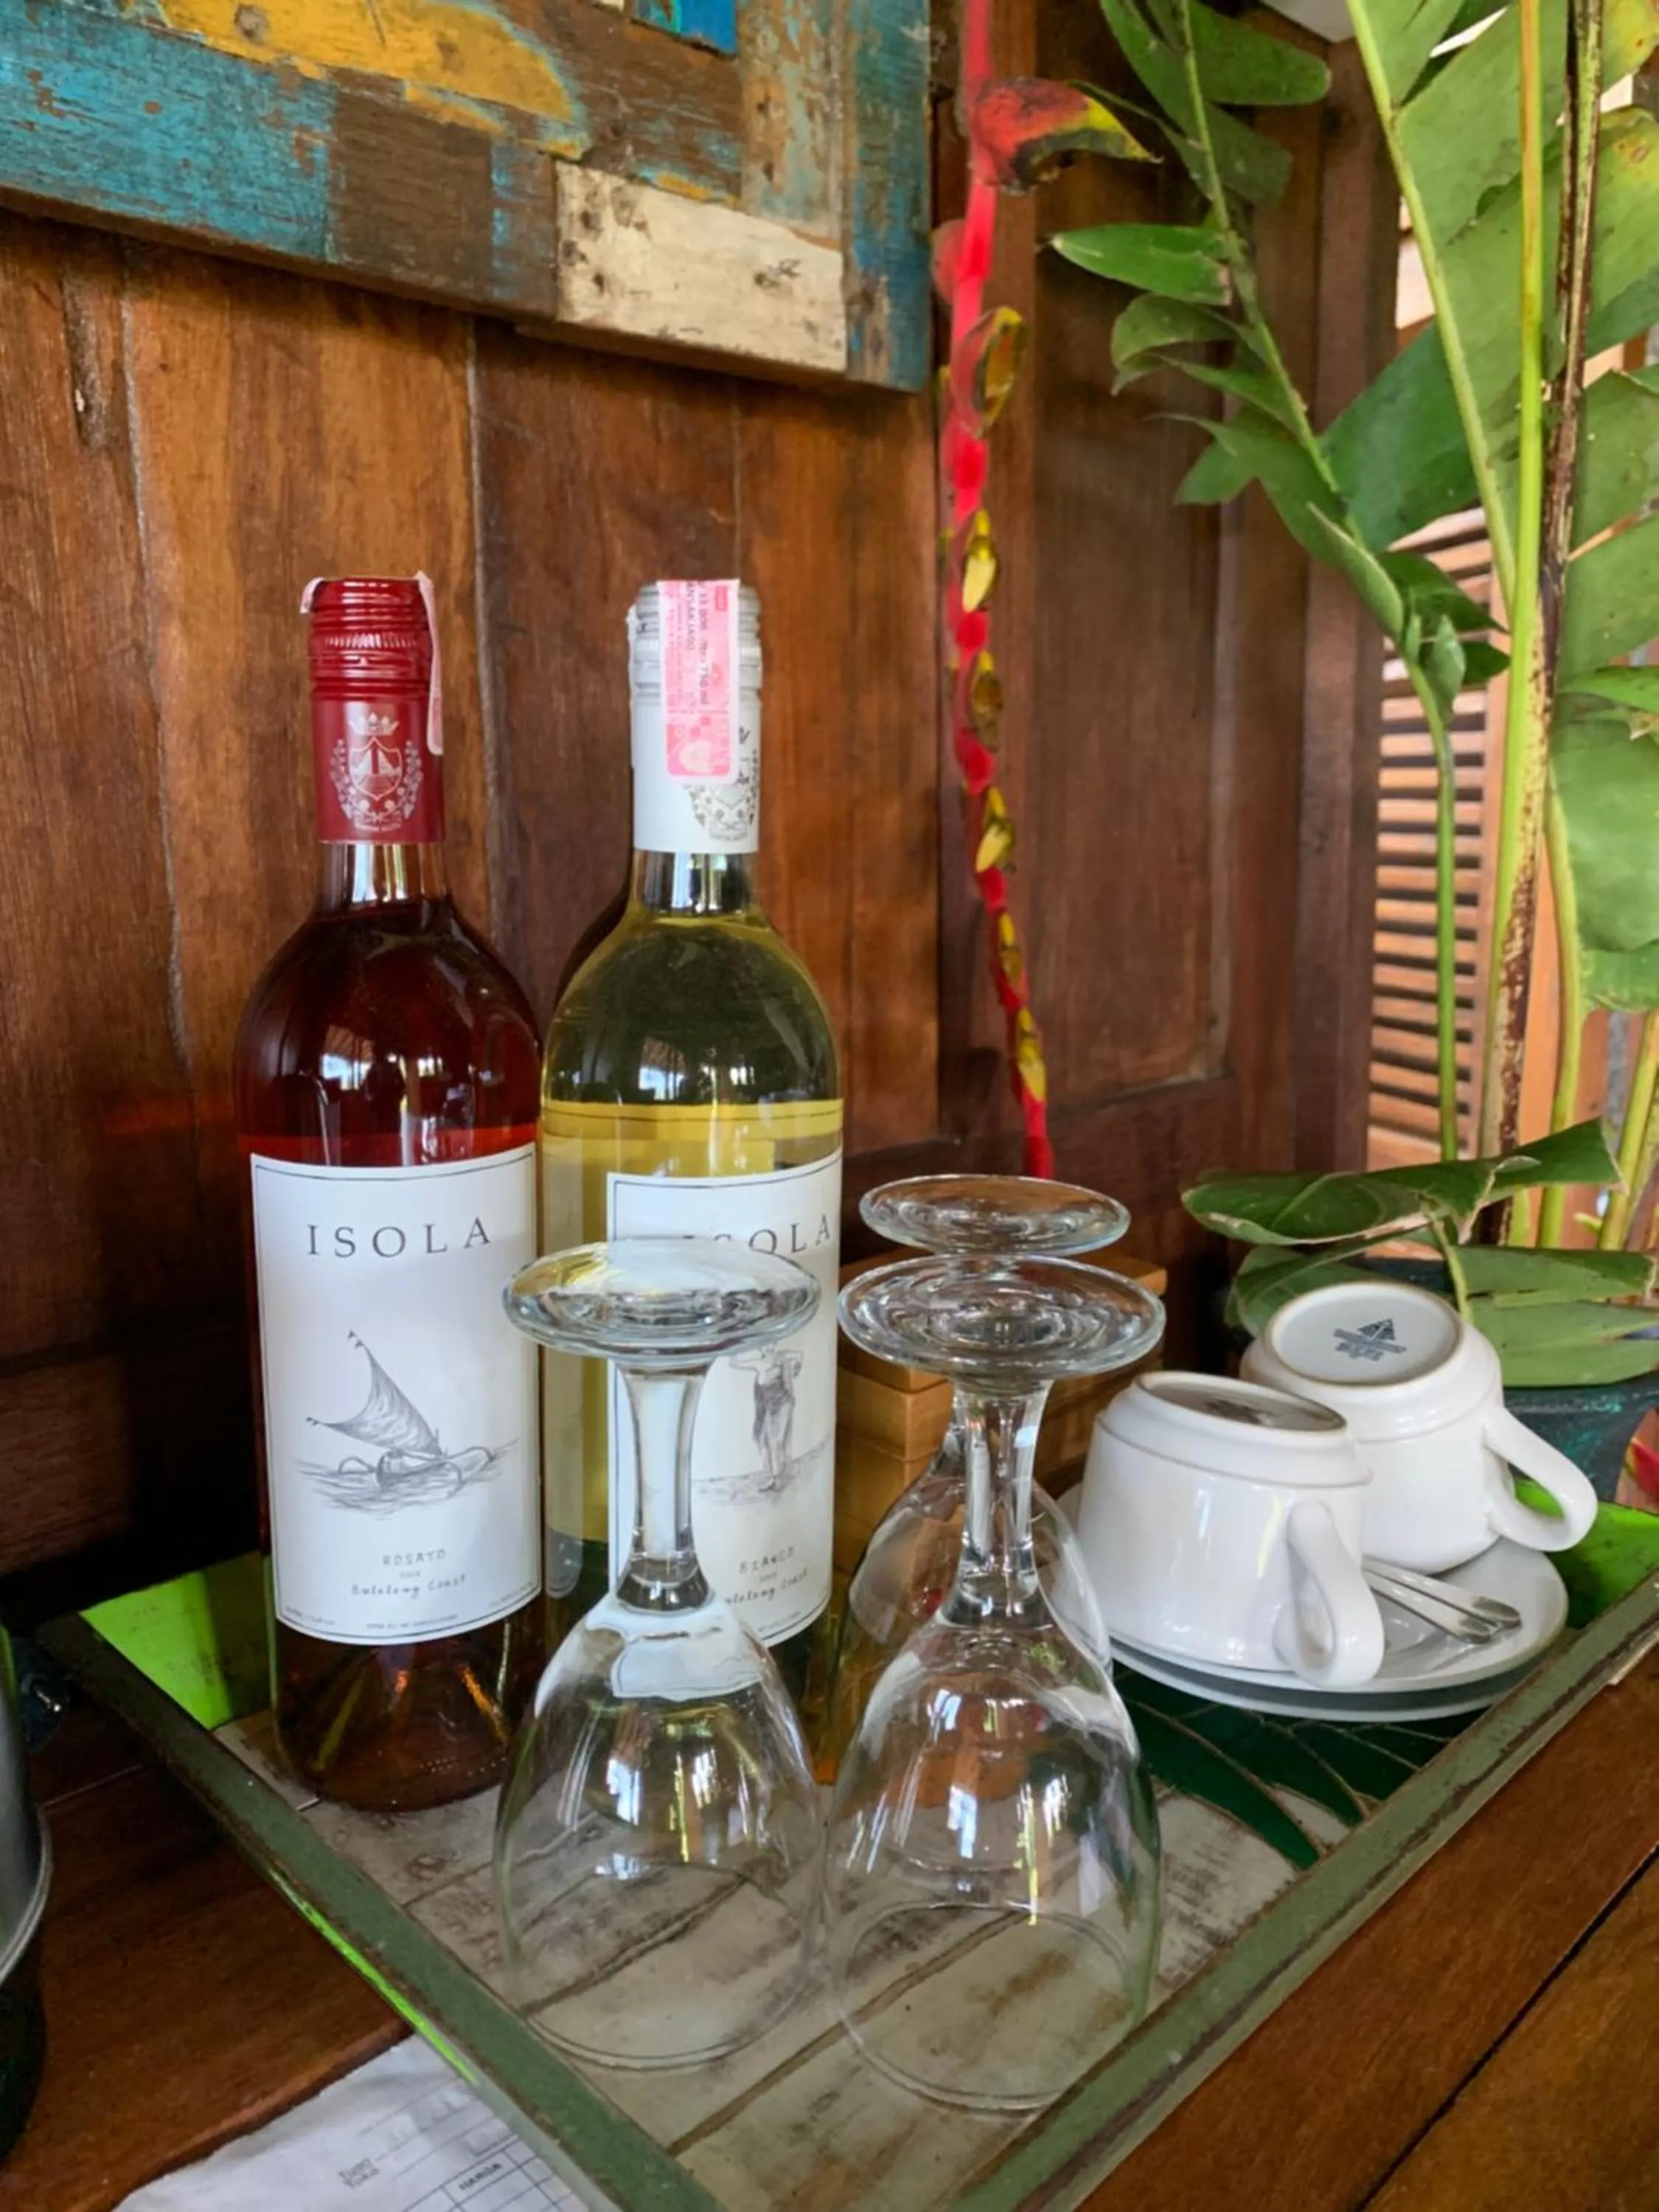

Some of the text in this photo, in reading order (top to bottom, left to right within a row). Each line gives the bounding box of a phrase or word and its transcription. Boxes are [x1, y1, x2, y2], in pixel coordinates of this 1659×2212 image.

[307, 1217, 490, 1258] ISOLA
[683, 1214, 830, 1255] OLA
[382, 1548, 445, 1565] ROSATO
